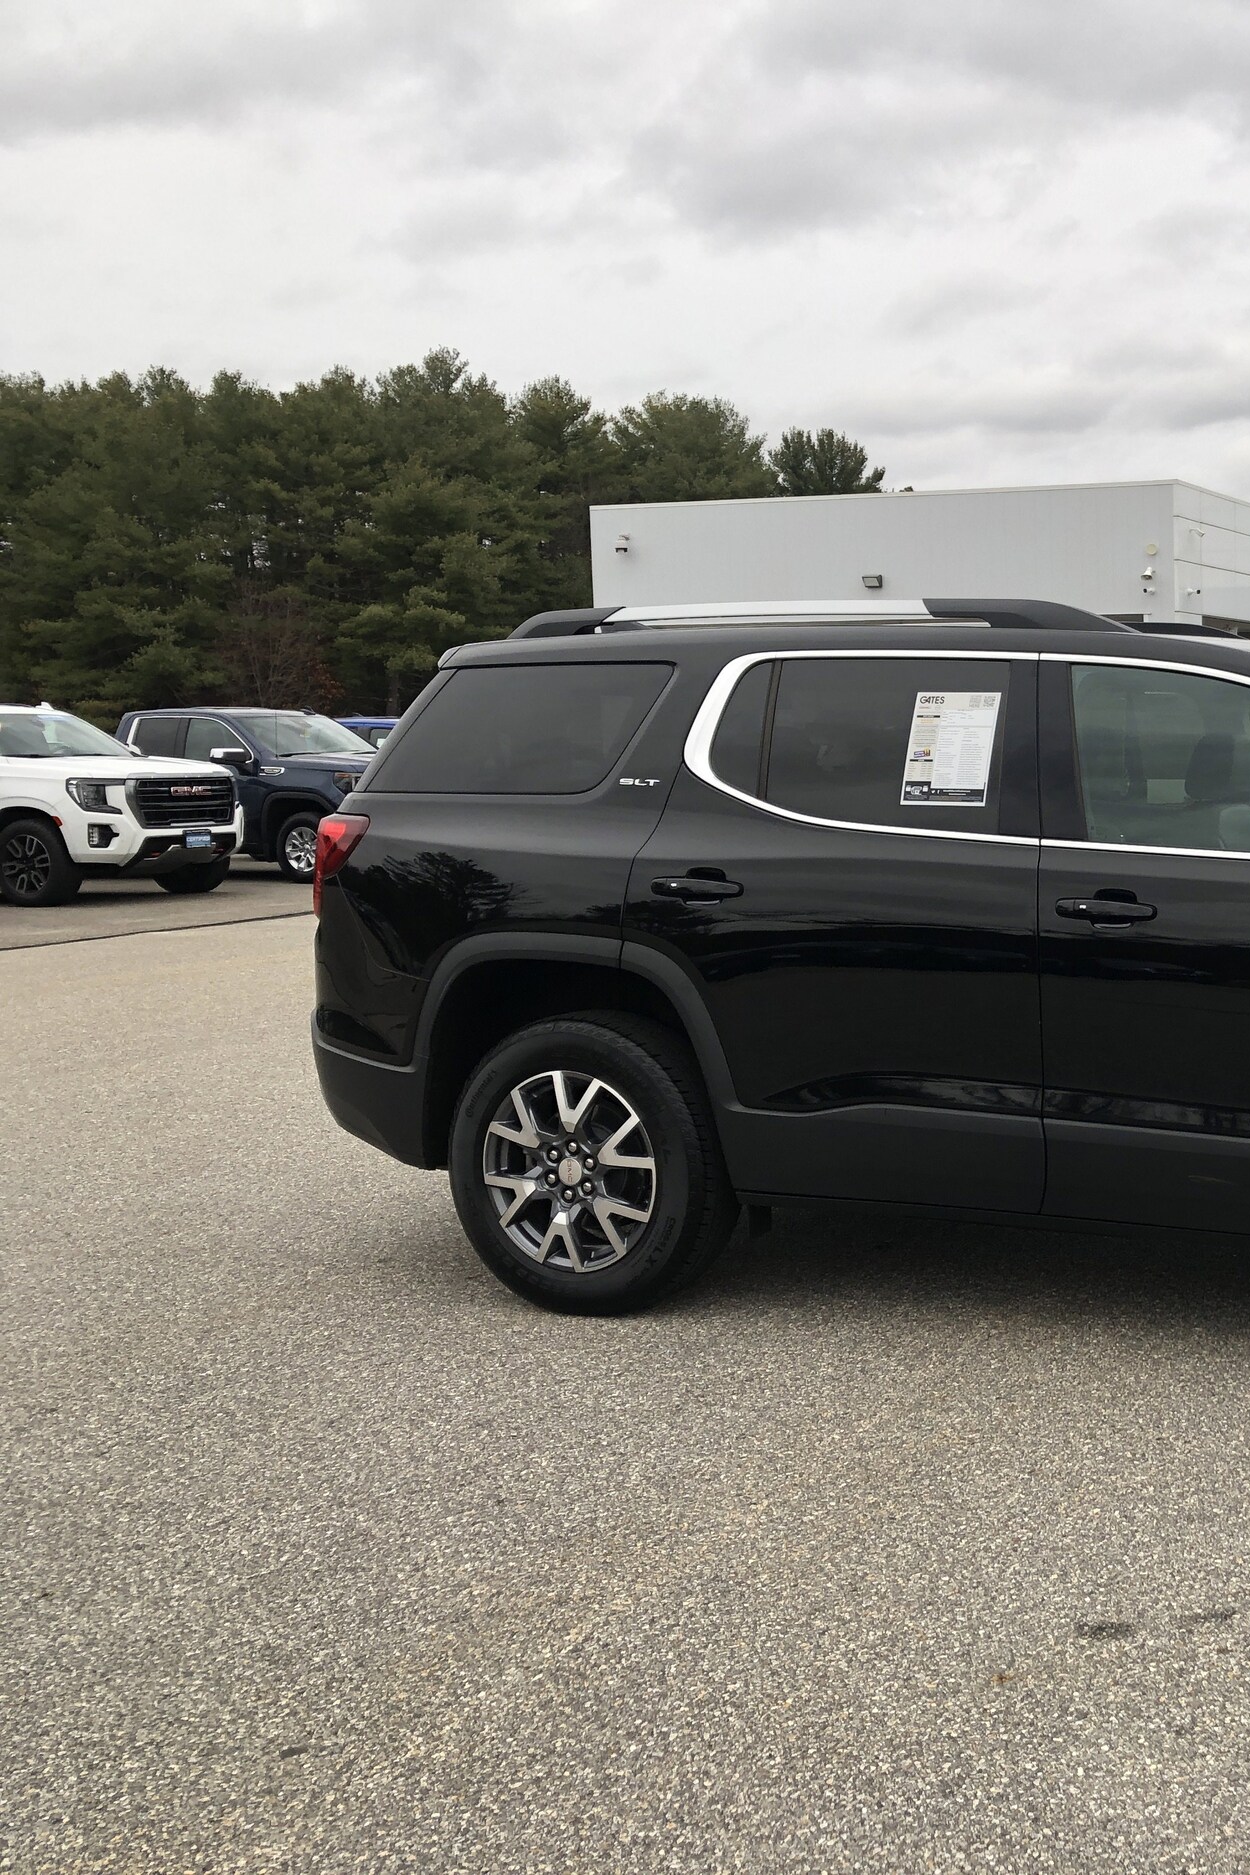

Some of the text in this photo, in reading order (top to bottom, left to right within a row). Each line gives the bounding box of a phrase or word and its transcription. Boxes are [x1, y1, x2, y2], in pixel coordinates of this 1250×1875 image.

[919, 695, 945, 704] GATES
[619, 777, 660, 787] SLT
[170, 785, 212, 797] GMC
[565, 1159, 574, 1183] GMC
